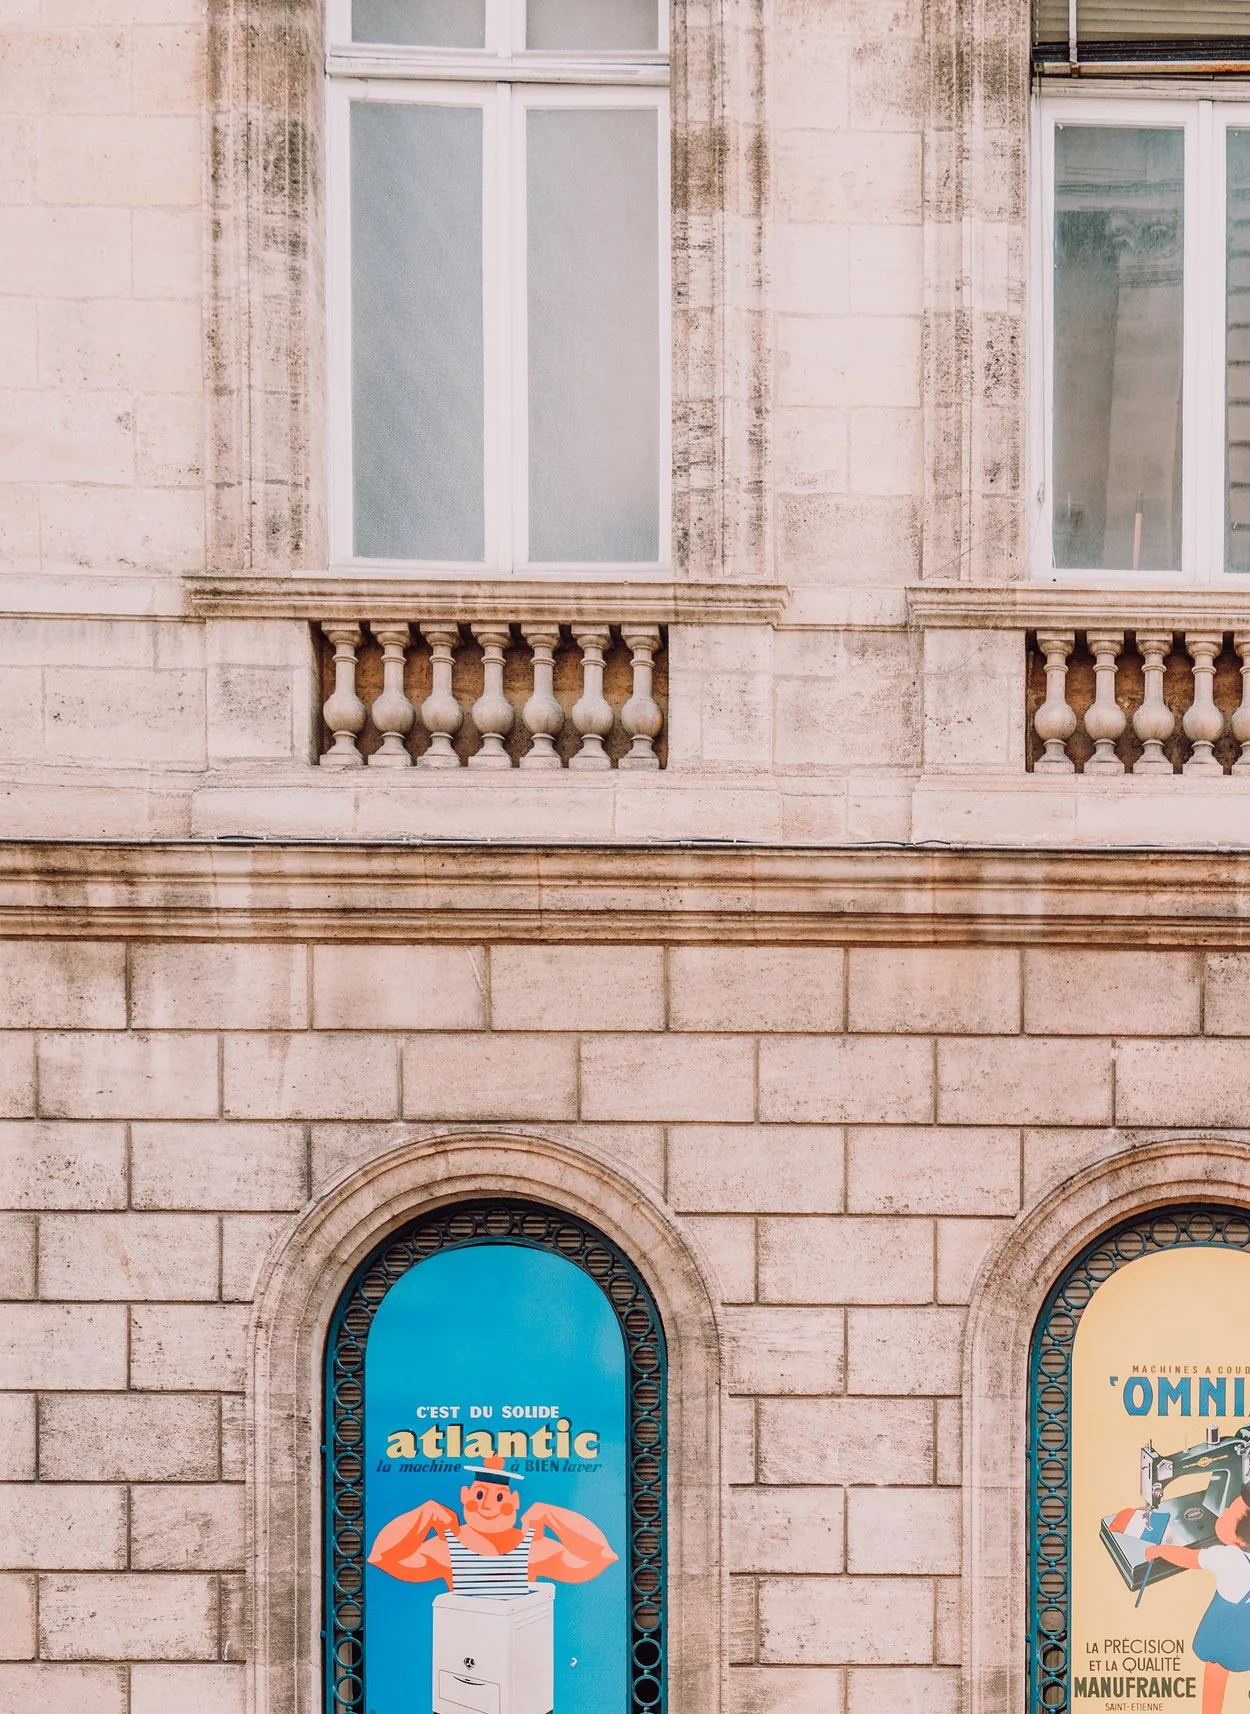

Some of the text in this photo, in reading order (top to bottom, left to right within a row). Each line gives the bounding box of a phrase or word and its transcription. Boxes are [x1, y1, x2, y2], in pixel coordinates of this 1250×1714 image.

[1132, 1365, 1198, 1374] MACHINES
[1205, 1366, 1212, 1374] A
[416, 1405, 559, 1419] C'EST DU SOLIDE
[386, 1417, 600, 1459] atlantic
[376, 1459, 602, 1473] la machine à BIEN laver
[1086, 1638, 1184, 1654] LA PRÉCISION
[1089, 1655, 1181, 1673] ET LA QUALITÉ
[1074, 1677, 1196, 1698] MANUFRANCE
